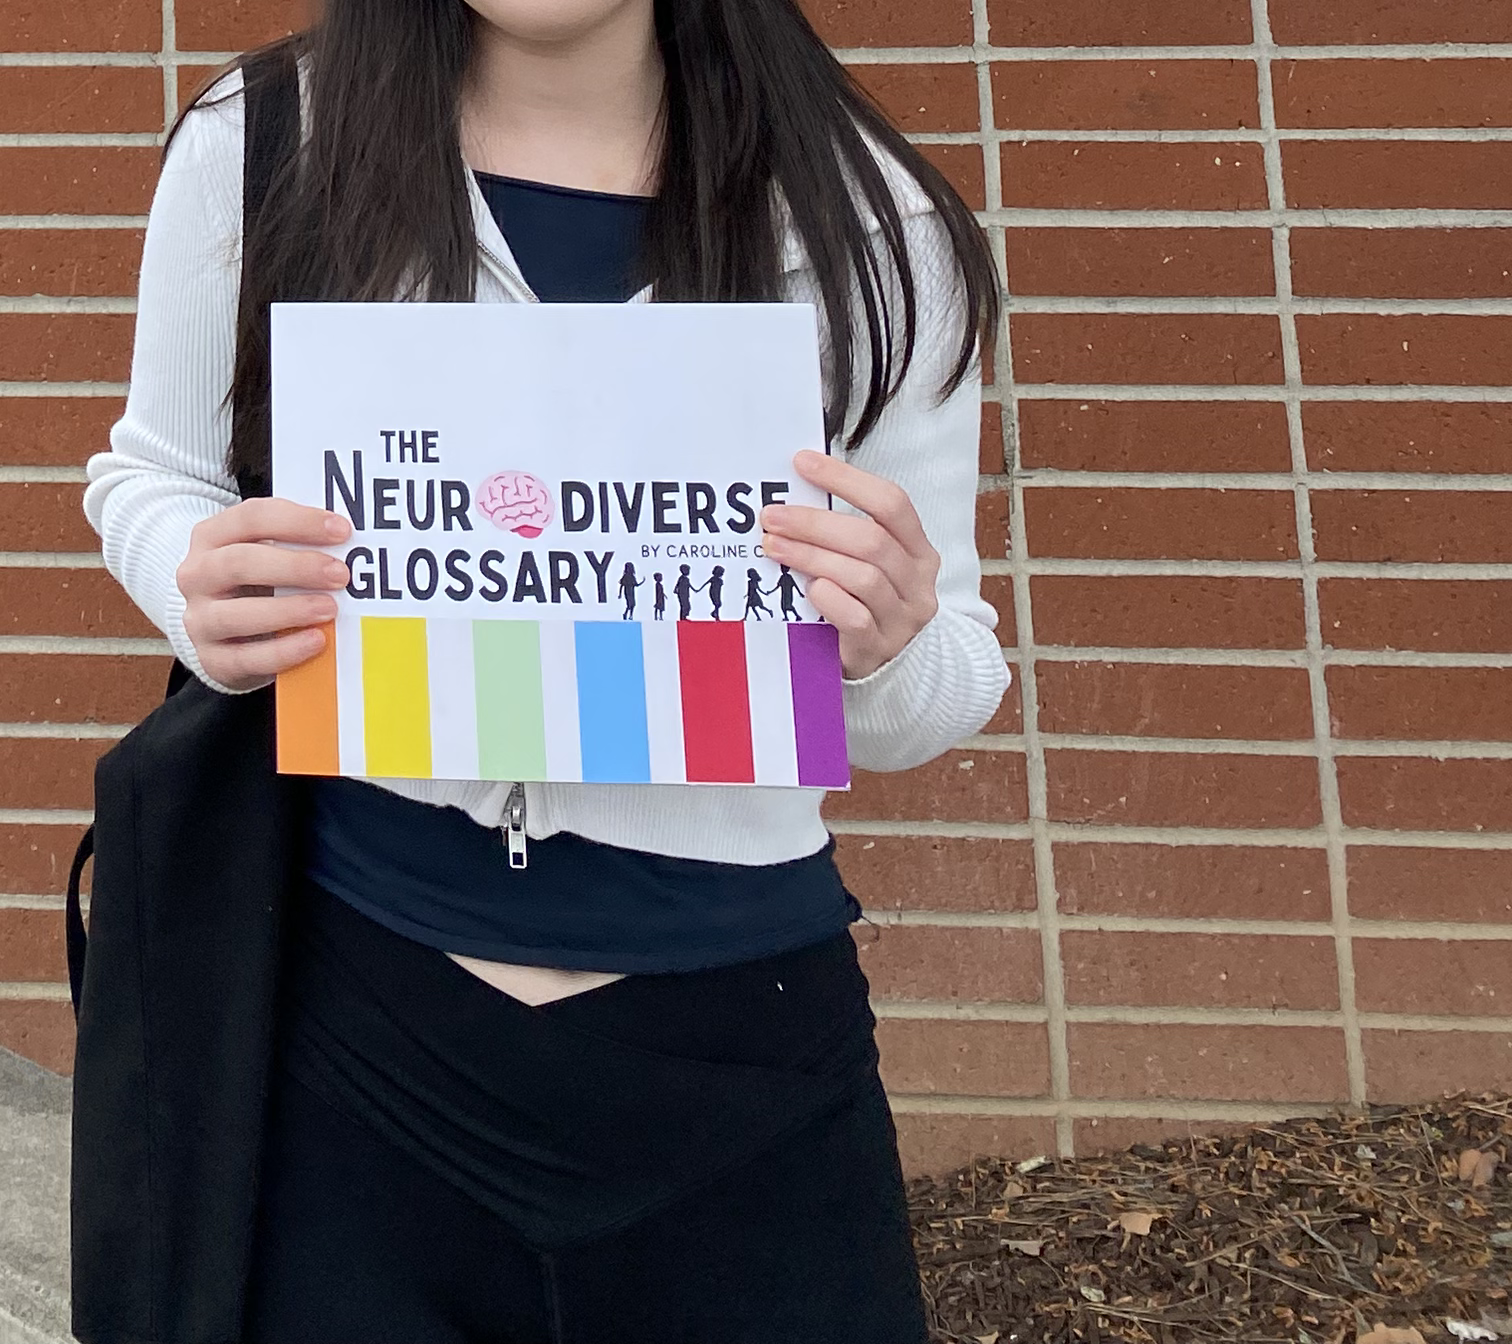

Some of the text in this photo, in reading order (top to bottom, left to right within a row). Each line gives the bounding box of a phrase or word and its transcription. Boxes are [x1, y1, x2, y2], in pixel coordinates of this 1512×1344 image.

[379, 430, 440, 463] THE
[641, 544, 661, 558] BY
[666, 544, 748, 558] CAROLINE
[344, 546, 615, 604] GLOSSARY
